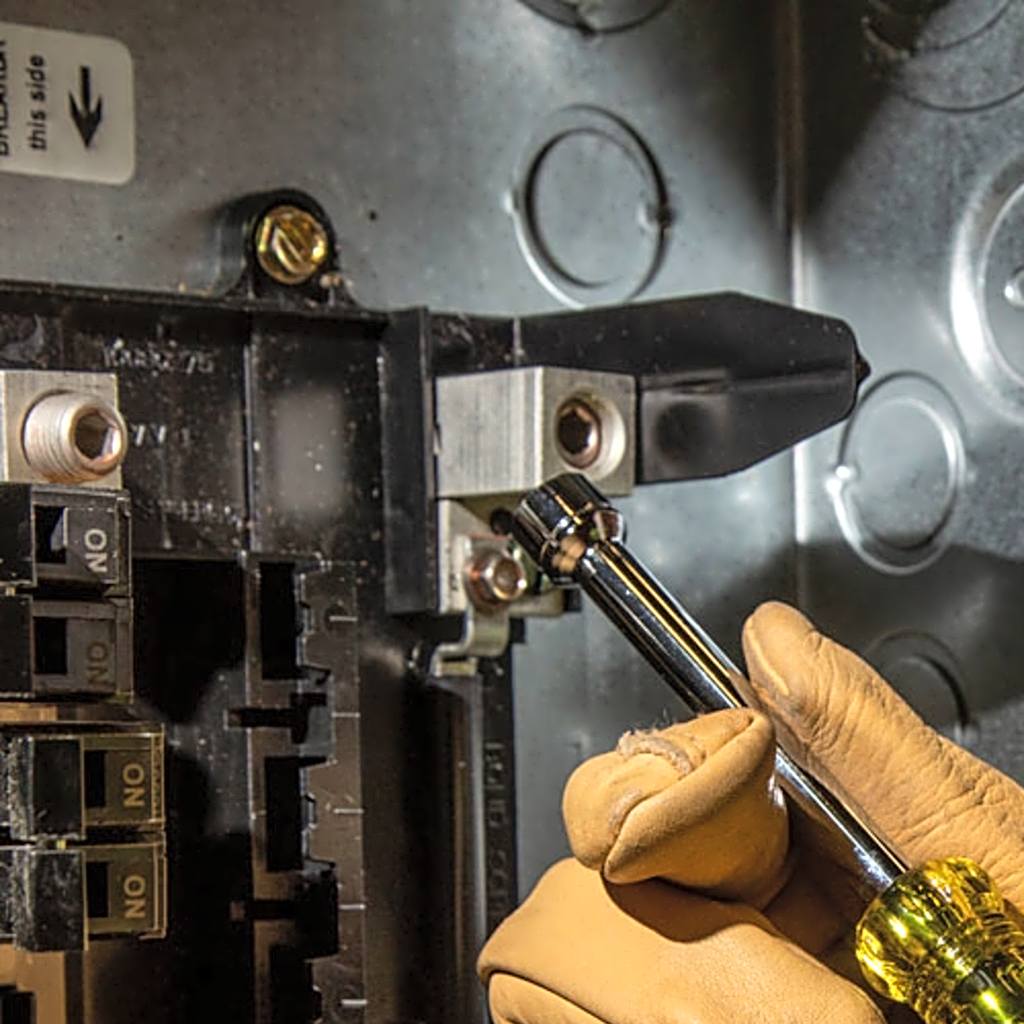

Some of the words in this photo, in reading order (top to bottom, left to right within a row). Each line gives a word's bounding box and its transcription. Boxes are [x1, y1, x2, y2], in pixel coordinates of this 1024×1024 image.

[25, 54, 45, 102] side
[27, 107, 47, 151] this
[84, 528, 108, 574] ON
[87, 640, 109, 685] ON
[123, 763, 145, 807] ON
[124, 875, 146, 919] ON
